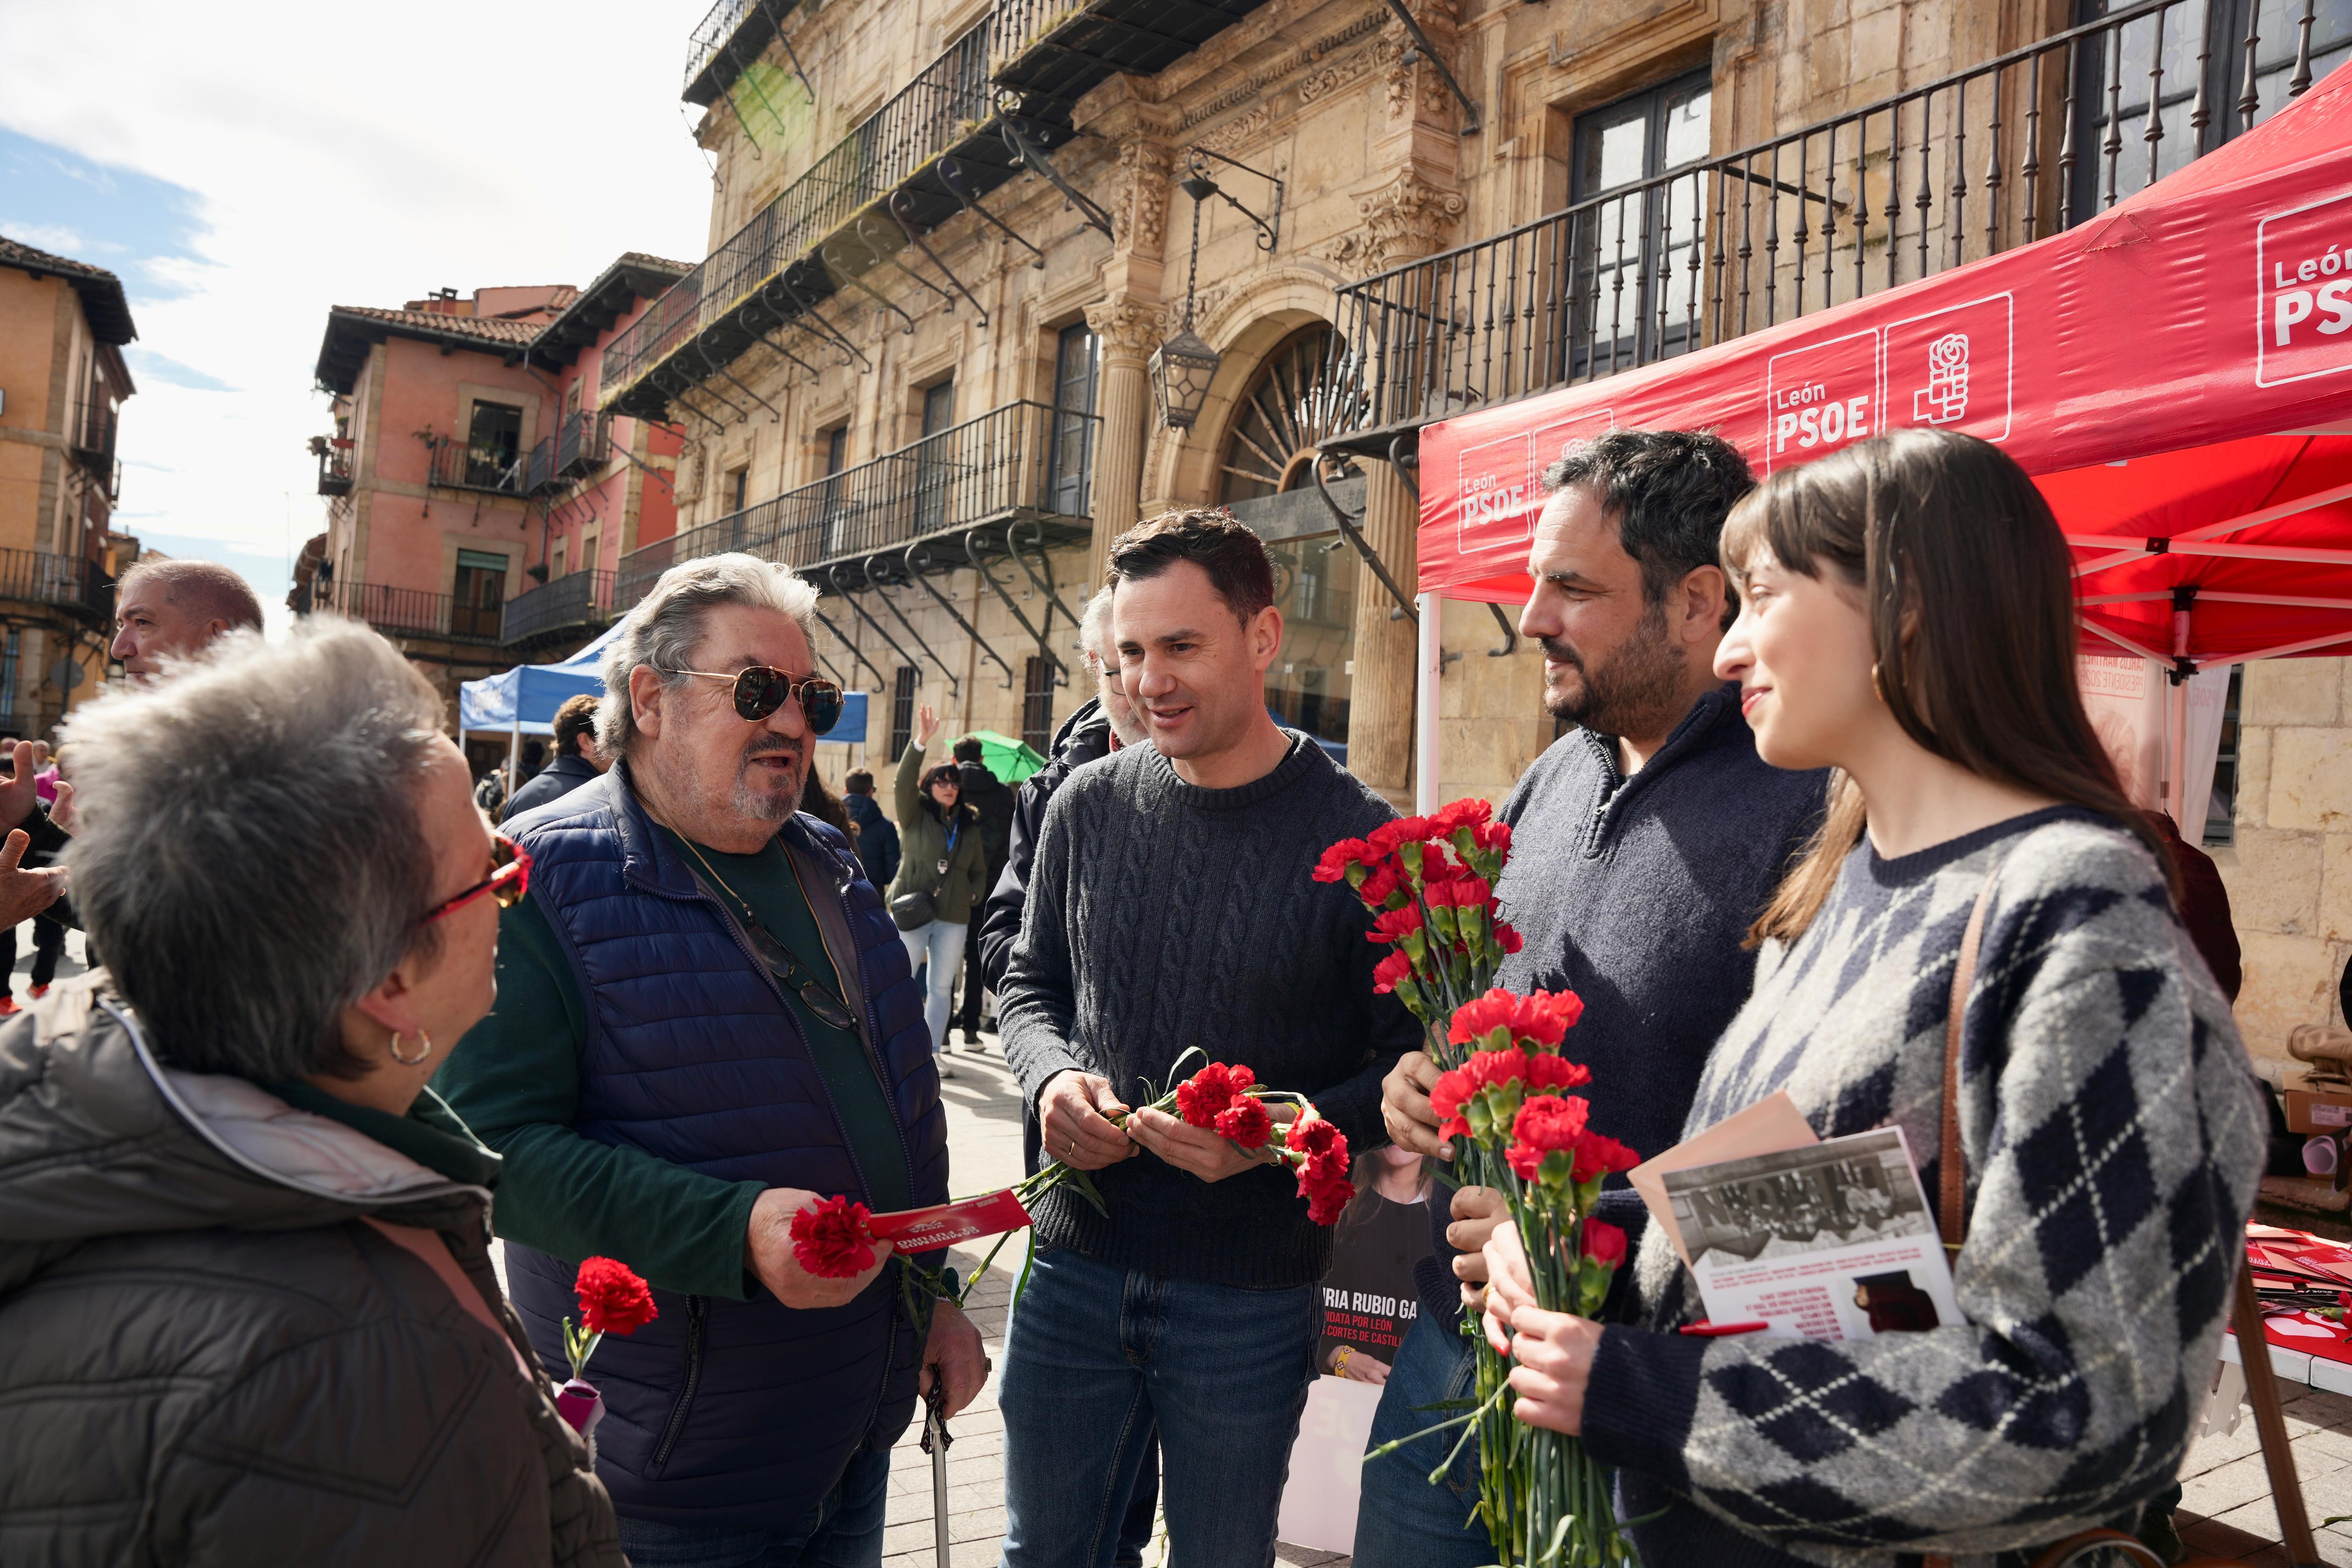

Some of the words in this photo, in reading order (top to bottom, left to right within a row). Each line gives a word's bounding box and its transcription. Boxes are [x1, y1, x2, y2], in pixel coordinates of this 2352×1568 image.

[2275, 279, 2352, 347] PS
[1777, 381, 1826, 410] León
[1776, 395, 1869, 453] PSOE
[1465, 472, 1496, 494] León
[1464, 484, 1524, 529] PSOE
[1323, 1287, 1349, 1310] RIA
[1352, 1292, 1396, 1317] RUBIO
[1326, 1311, 1350, 1325] IDATA
[1352, 1315, 1369, 1328] POR
[1370, 1318, 1393, 1332] LEÓN
[1327, 1325, 1358, 1340] CORTES
[1359, 1330, 1370, 1342] DE
